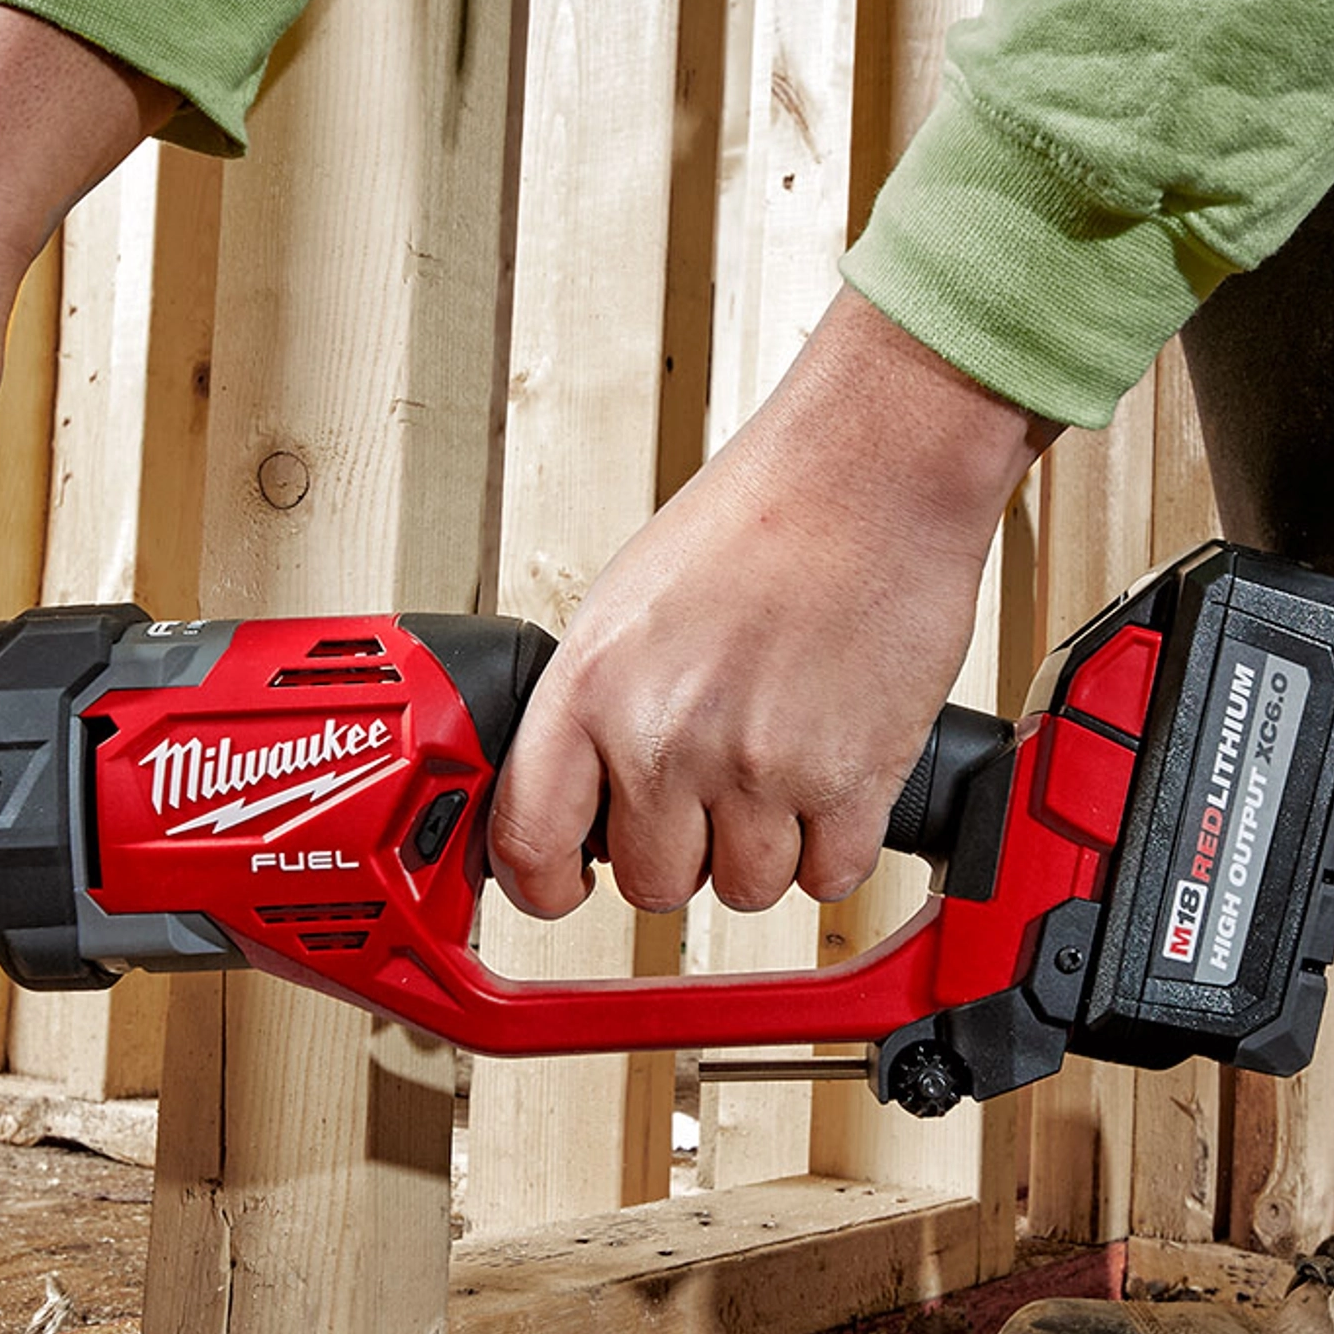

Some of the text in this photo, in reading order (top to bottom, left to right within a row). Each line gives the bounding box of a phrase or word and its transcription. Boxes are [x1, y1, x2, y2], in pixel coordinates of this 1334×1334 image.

[138, 718, 392, 815] Milwaukee
[251, 850, 360, 873] FUEL
[1169, 662, 1256, 956] M18 REDLITHIUM
[1209, 672, 1288, 970] HIGH OUTPUT XC6.0
